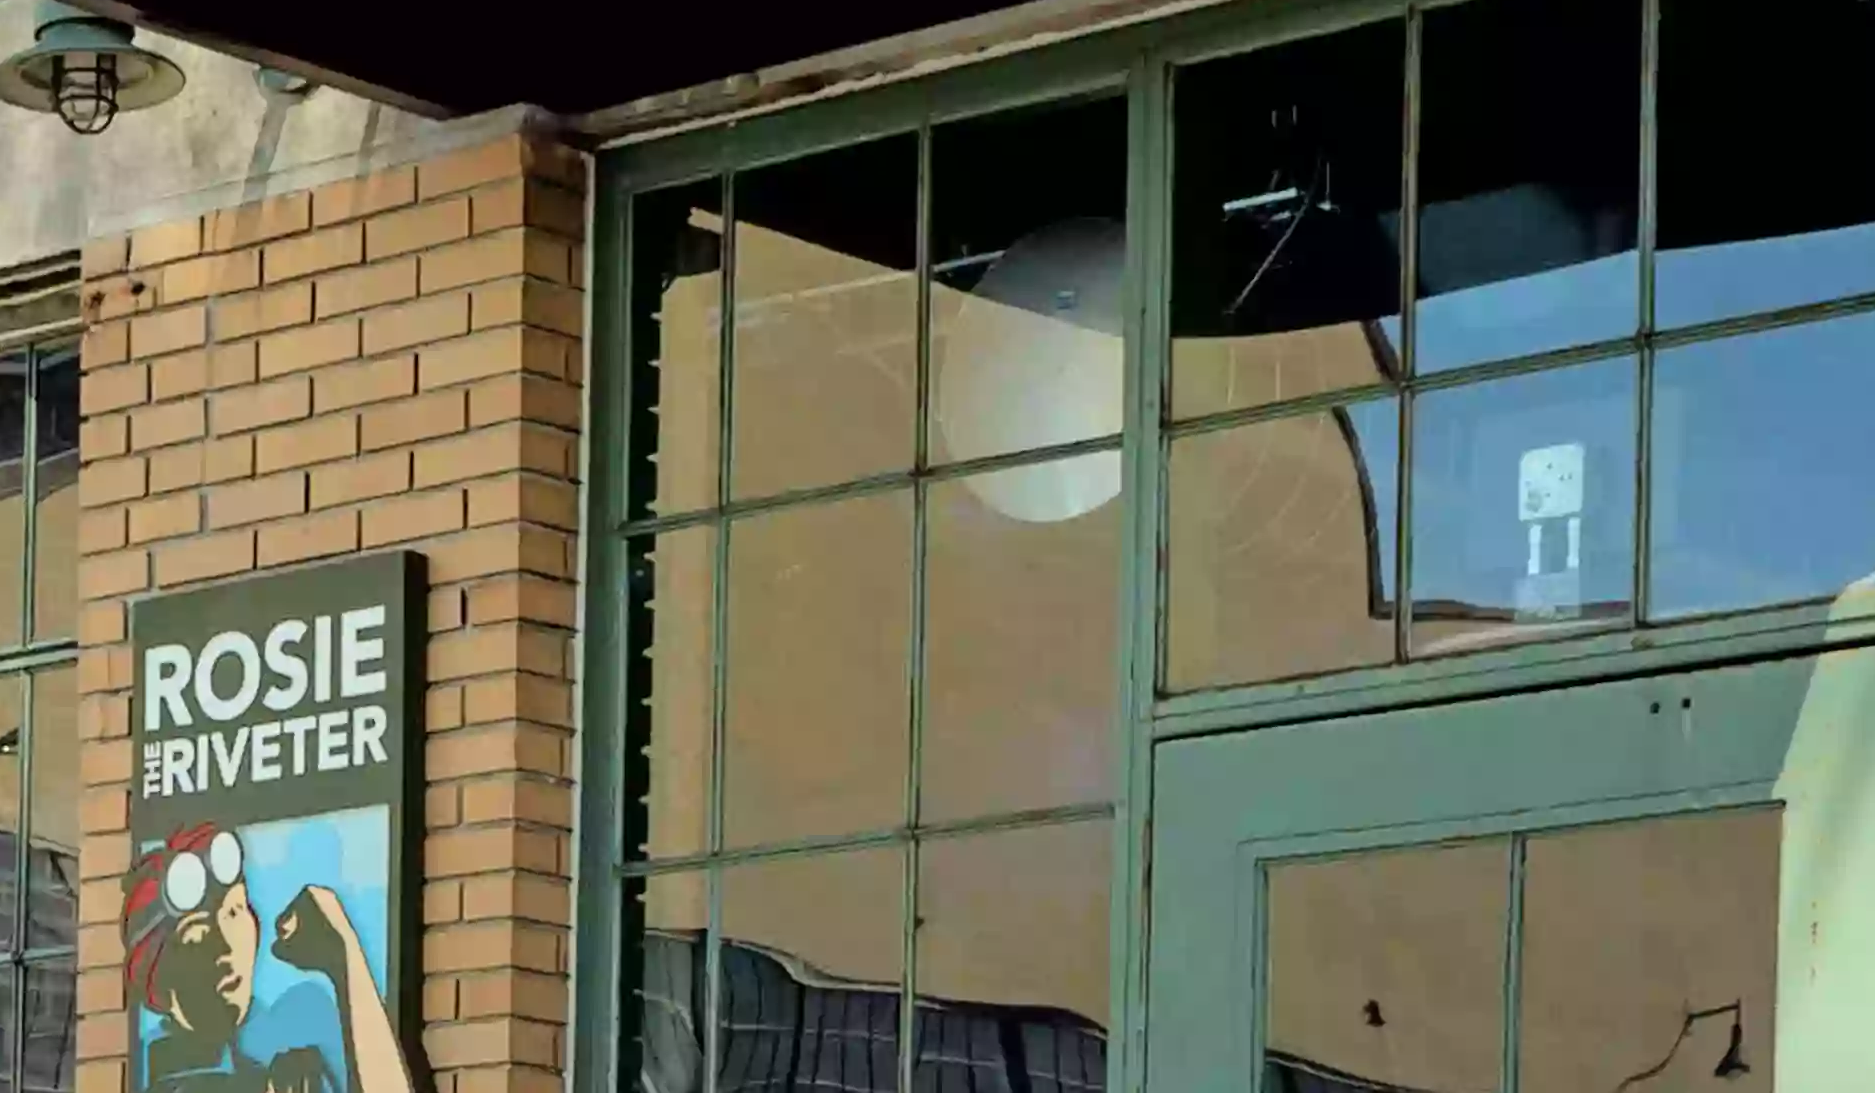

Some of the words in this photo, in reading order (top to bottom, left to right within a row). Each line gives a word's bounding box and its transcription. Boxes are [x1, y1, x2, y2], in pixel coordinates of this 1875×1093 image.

[143, 605, 387, 732] ROSIE
[143, 740, 163, 799] THE
[162, 705, 388, 797] RIVETER
